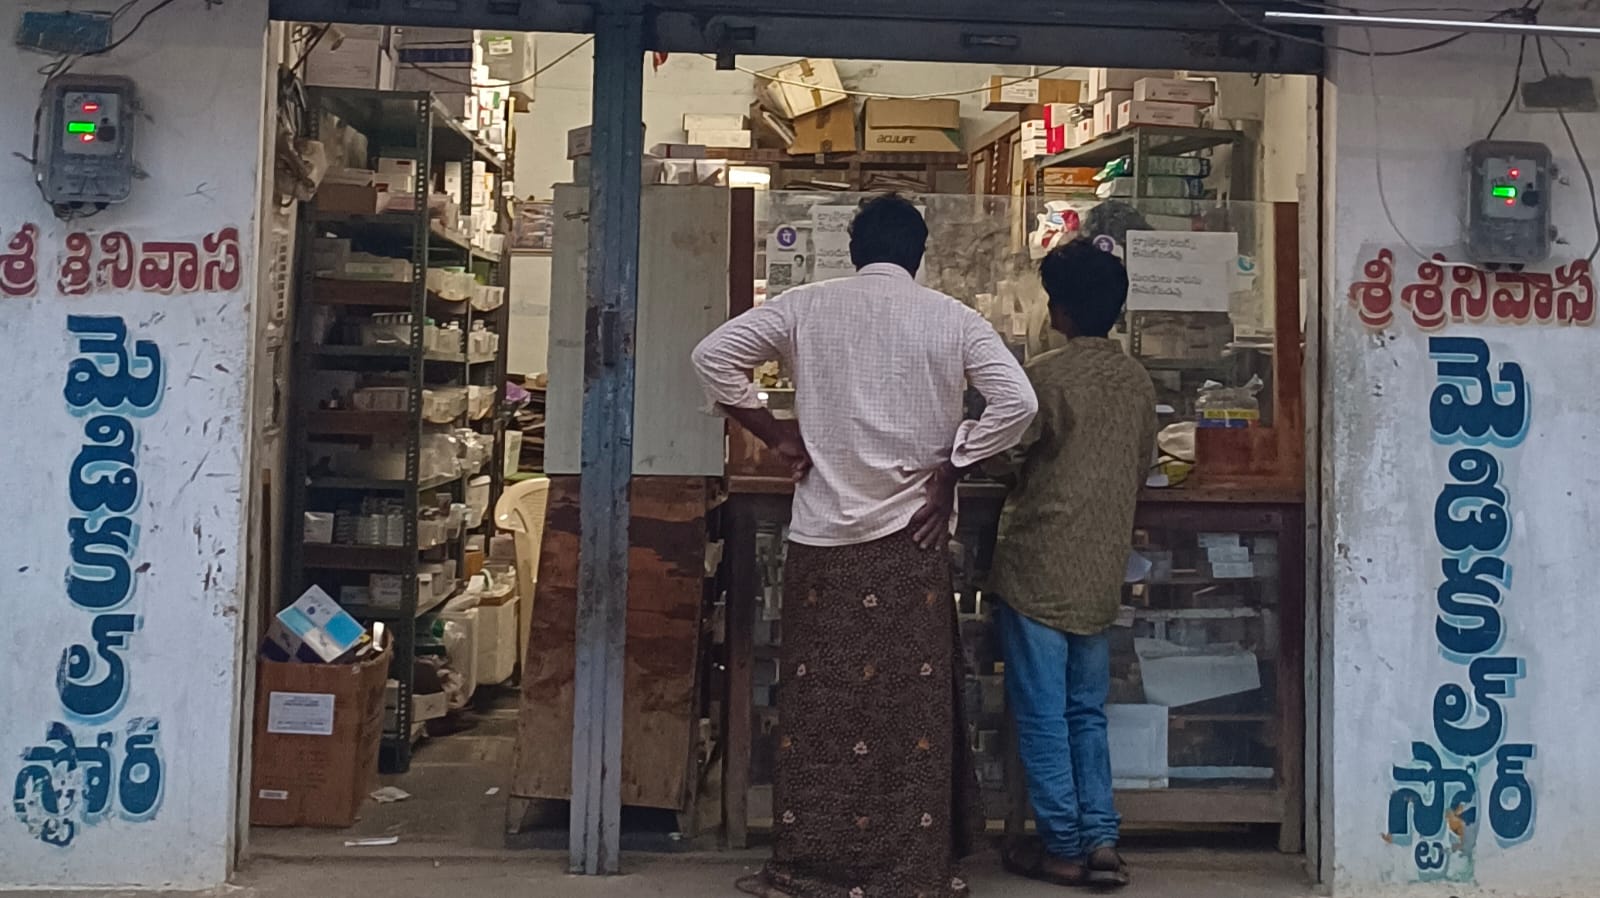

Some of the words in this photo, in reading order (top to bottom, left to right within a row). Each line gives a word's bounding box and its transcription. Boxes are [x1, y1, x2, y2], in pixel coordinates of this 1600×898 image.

[0, 222, 38, 296] శ్రీ
[1348, 247, 1394, 328] శ్రీ
[1400, 252, 1596, 330] శ్రీనివాస
[56, 314, 165, 722] మెడికల్
[1428, 336, 1531, 758] మెడికల్
